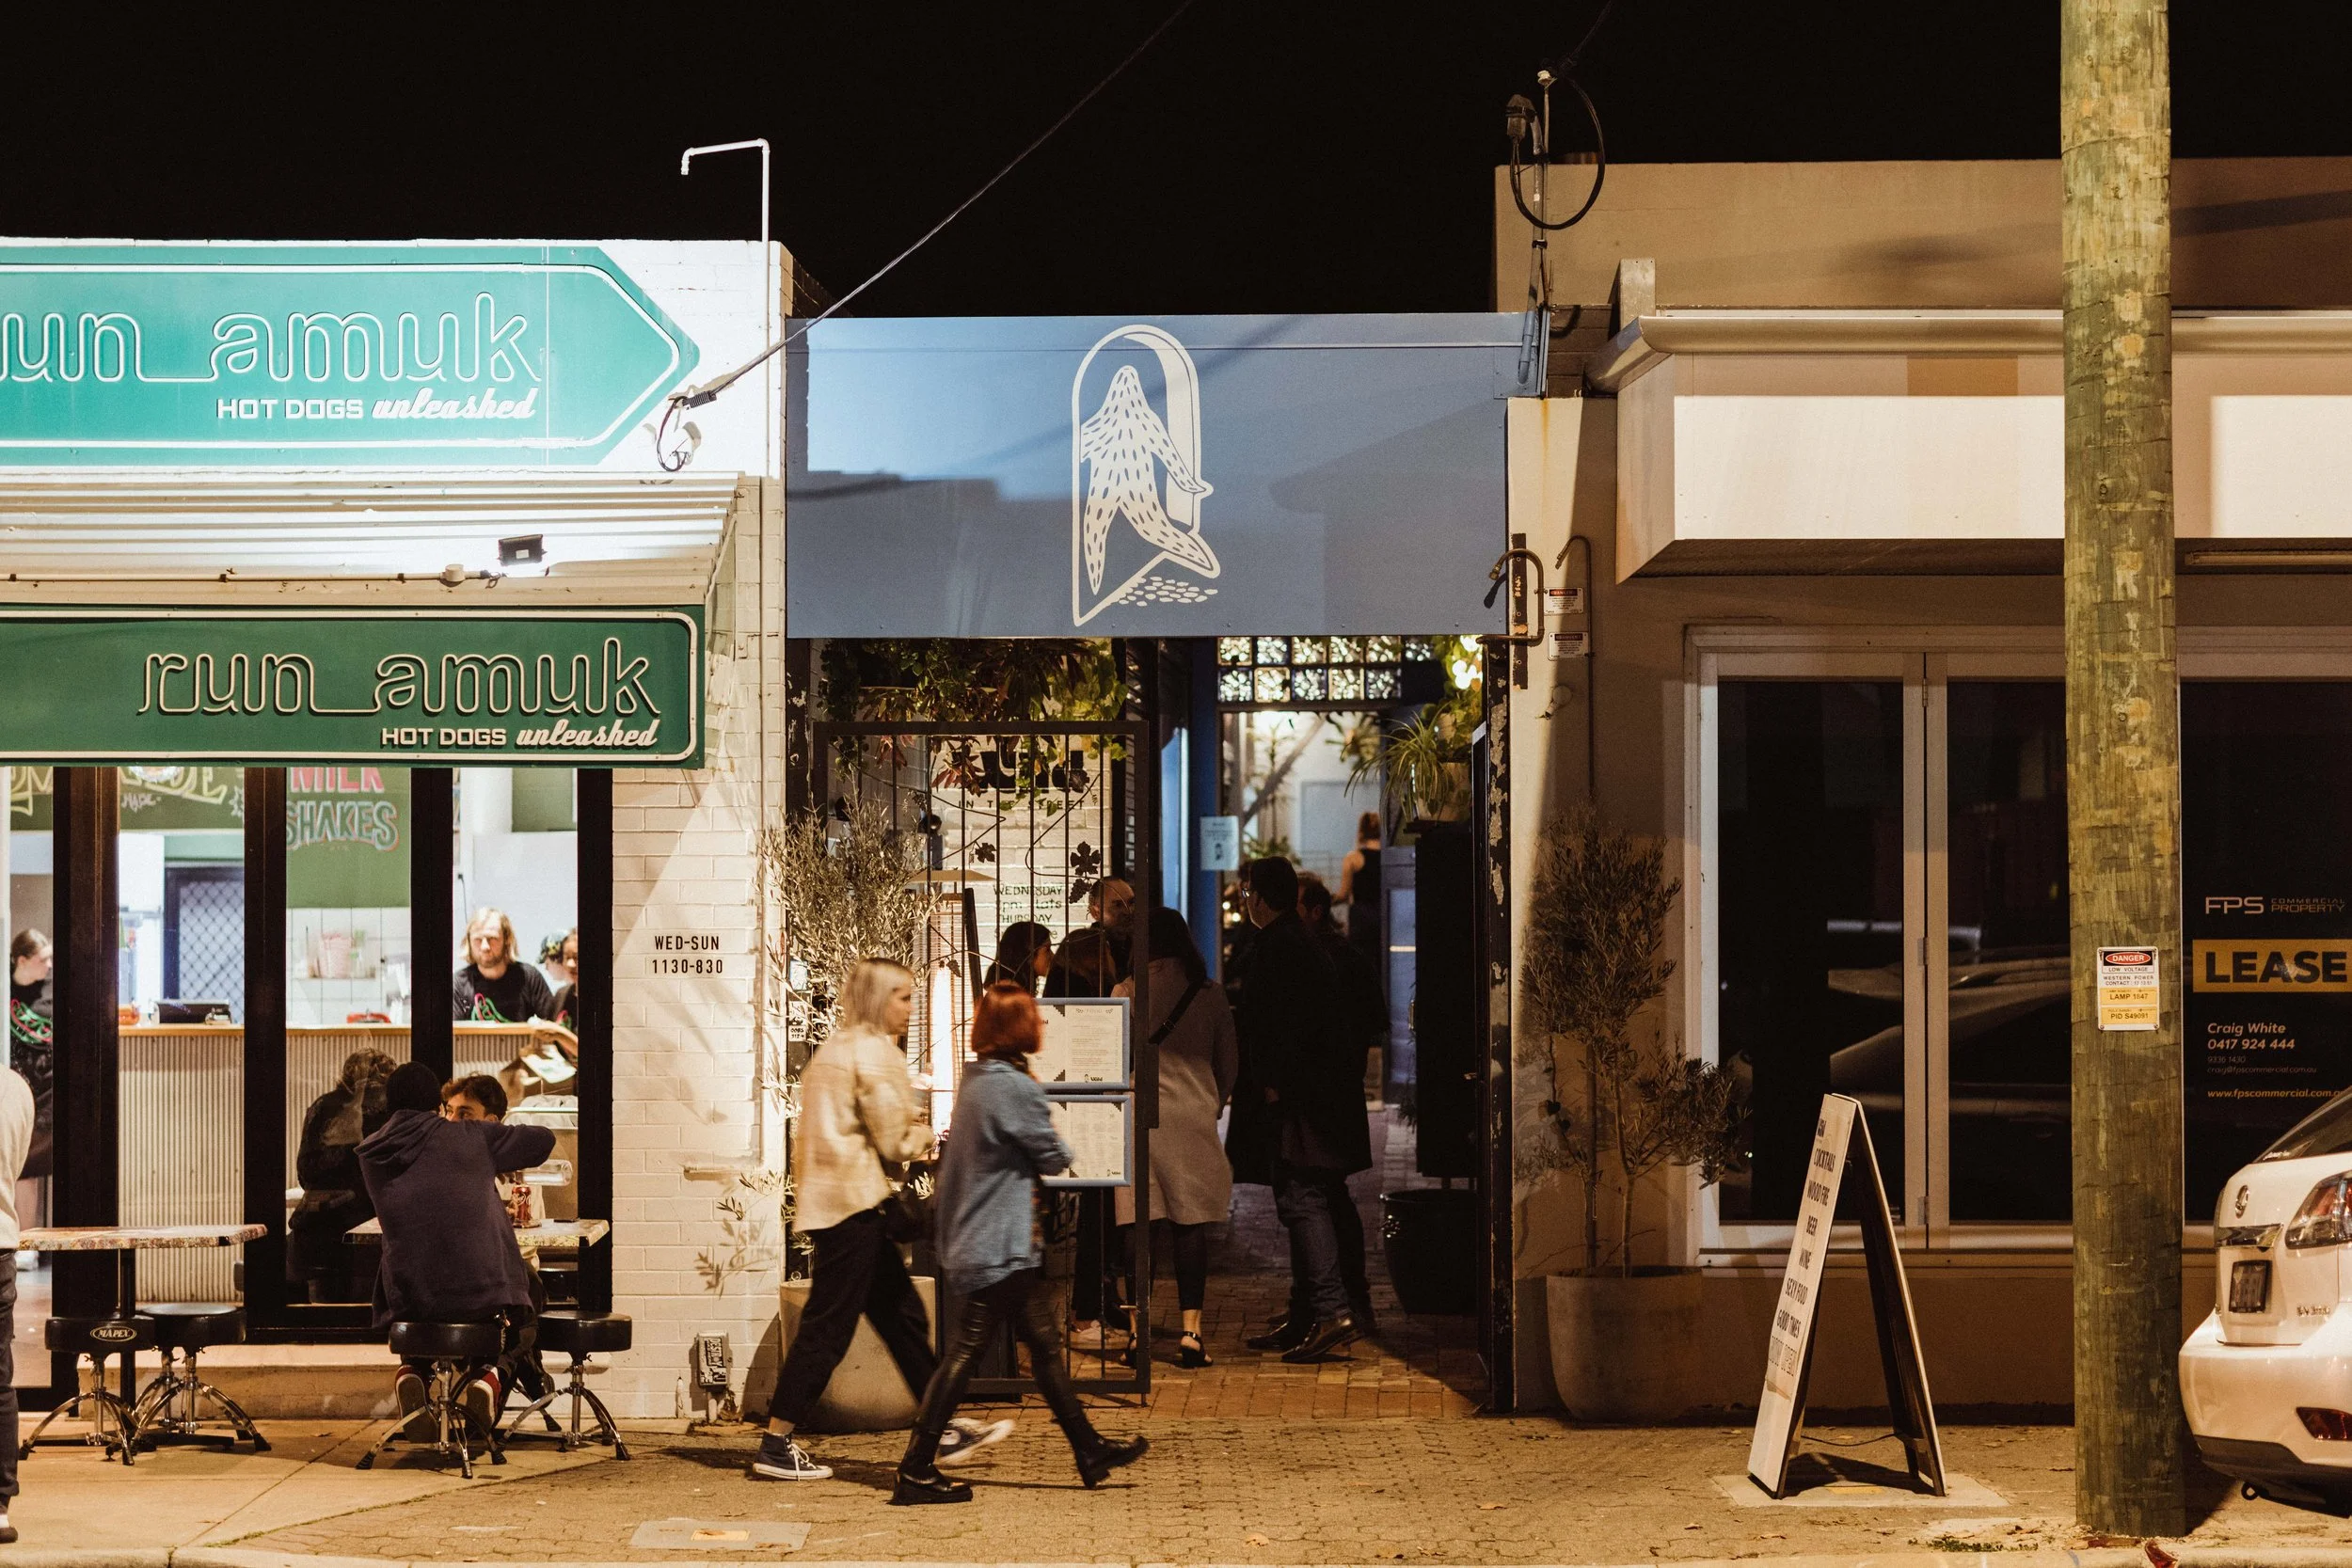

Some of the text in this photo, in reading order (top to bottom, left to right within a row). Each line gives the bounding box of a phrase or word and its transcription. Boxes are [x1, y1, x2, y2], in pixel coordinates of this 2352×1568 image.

[0, 292, 543, 382] un amuk
[217, 387, 539, 420] HOT DOGS unleashed
[137, 637, 660, 716] run amuk
[382, 719, 659, 748] HOT DOGS unleashed
[286, 800, 400, 851] SHAKES
[993, 885, 1063, 896] WEDNSDAY
[2205, 896, 2265, 915] FPS
[2270, 904, 2345, 913] PROPERTY
[654, 935, 720, 951] WED-SUN
[652, 958, 723, 974] 1130-830
[2205, 950, 2348, 984] LEASE
[2207, 1022, 2286, 1037] Craig White
[2207, 1038, 2296, 1050] 0417 924 444
[2207, 1088, 2345, 1100] www.fpscommercial.com.a
[1806, 1215, 1818, 1236] BEER
[97, 1329, 130, 1338] MAPEX
